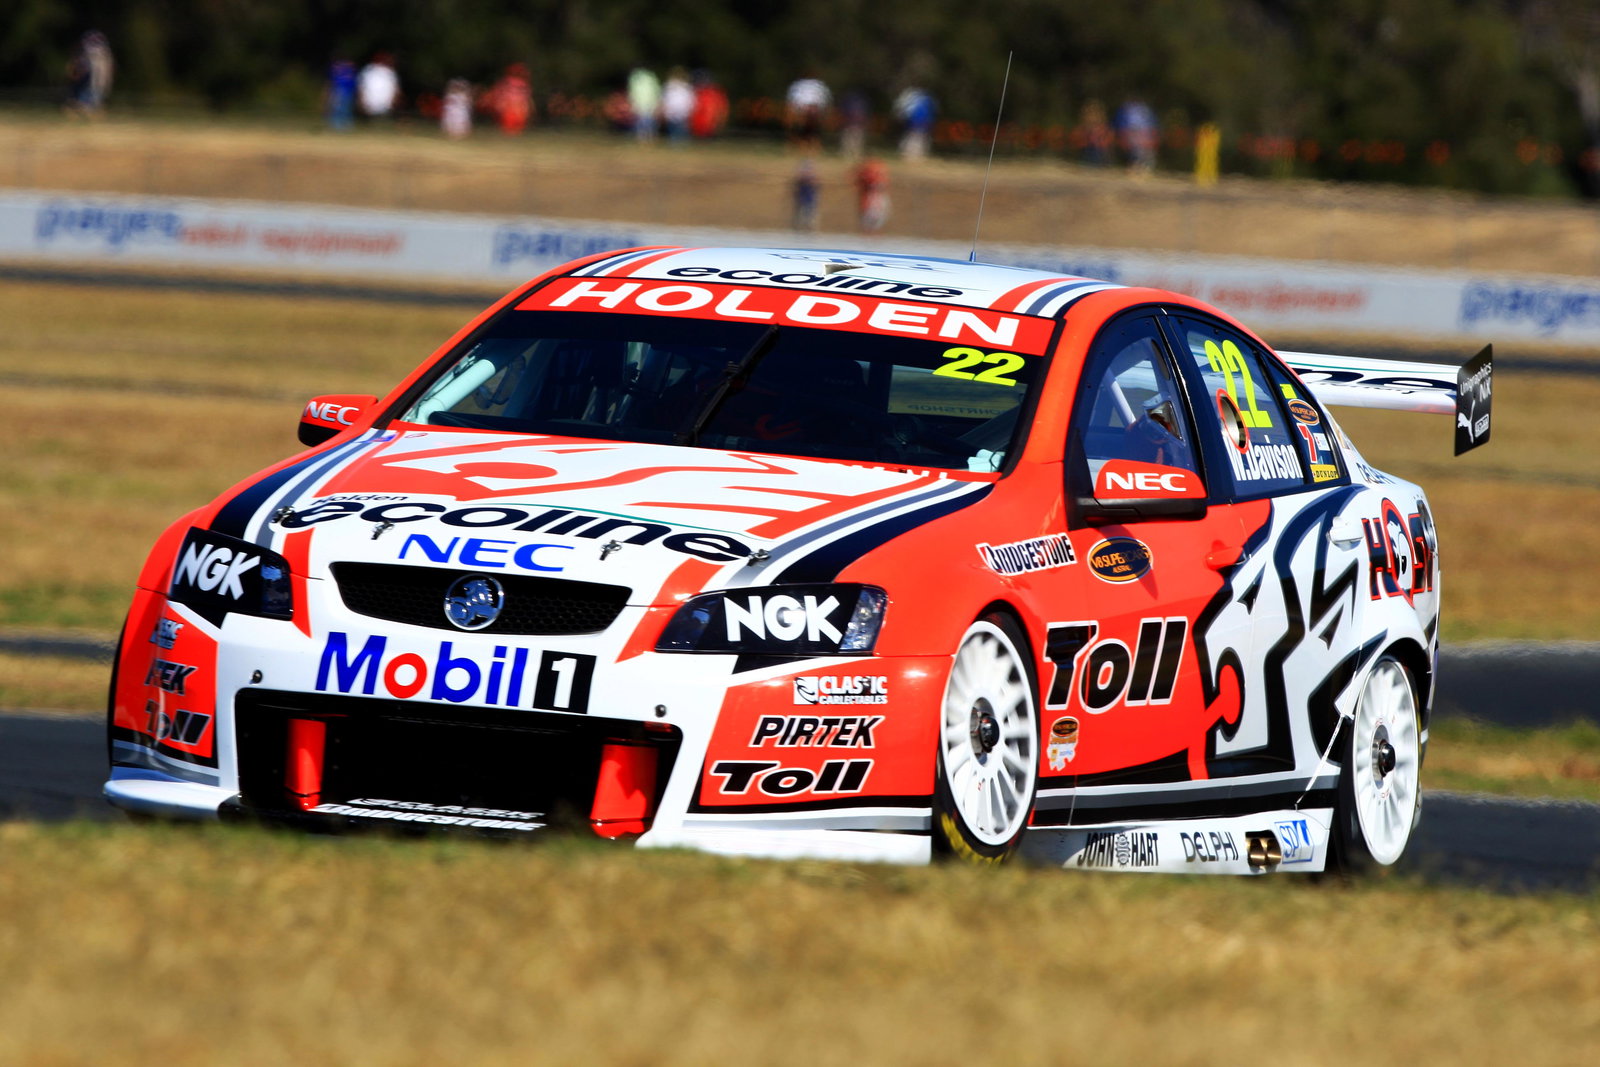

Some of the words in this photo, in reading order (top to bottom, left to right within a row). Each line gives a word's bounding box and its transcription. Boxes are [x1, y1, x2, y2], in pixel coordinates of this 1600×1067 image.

[667, 266, 963, 298] ecoline
[548, 281, 1020, 346] HOLDEN
[932, 347, 1025, 387] 22
[1204, 339, 1273, 427] 22
[303, 401, 359, 426] NEC
[1105, 472, 1187, 492] NEC
[1315, 470, 1338, 479] DUNLOP
[311, 494, 409, 507] Holden
[280, 502, 753, 562] ecoline
[174, 541, 261, 600] NGK
[398, 533, 575, 572] NEC
[977, 534, 1075, 575] BRIDGESTONE
[723, 595, 843, 645] NGK
[315, 631, 529, 707] Mobil
[550, 657, 578, 709] 1
[1043, 616, 1188, 714] Toll
[748, 715, 885, 748] PIRTEK
[710, 759, 874, 797] Toll
[1077, 832, 1116, 868] JOHN
[1131, 832, 1159, 867] HART
[1179, 830, 1239, 863] DELPHI
